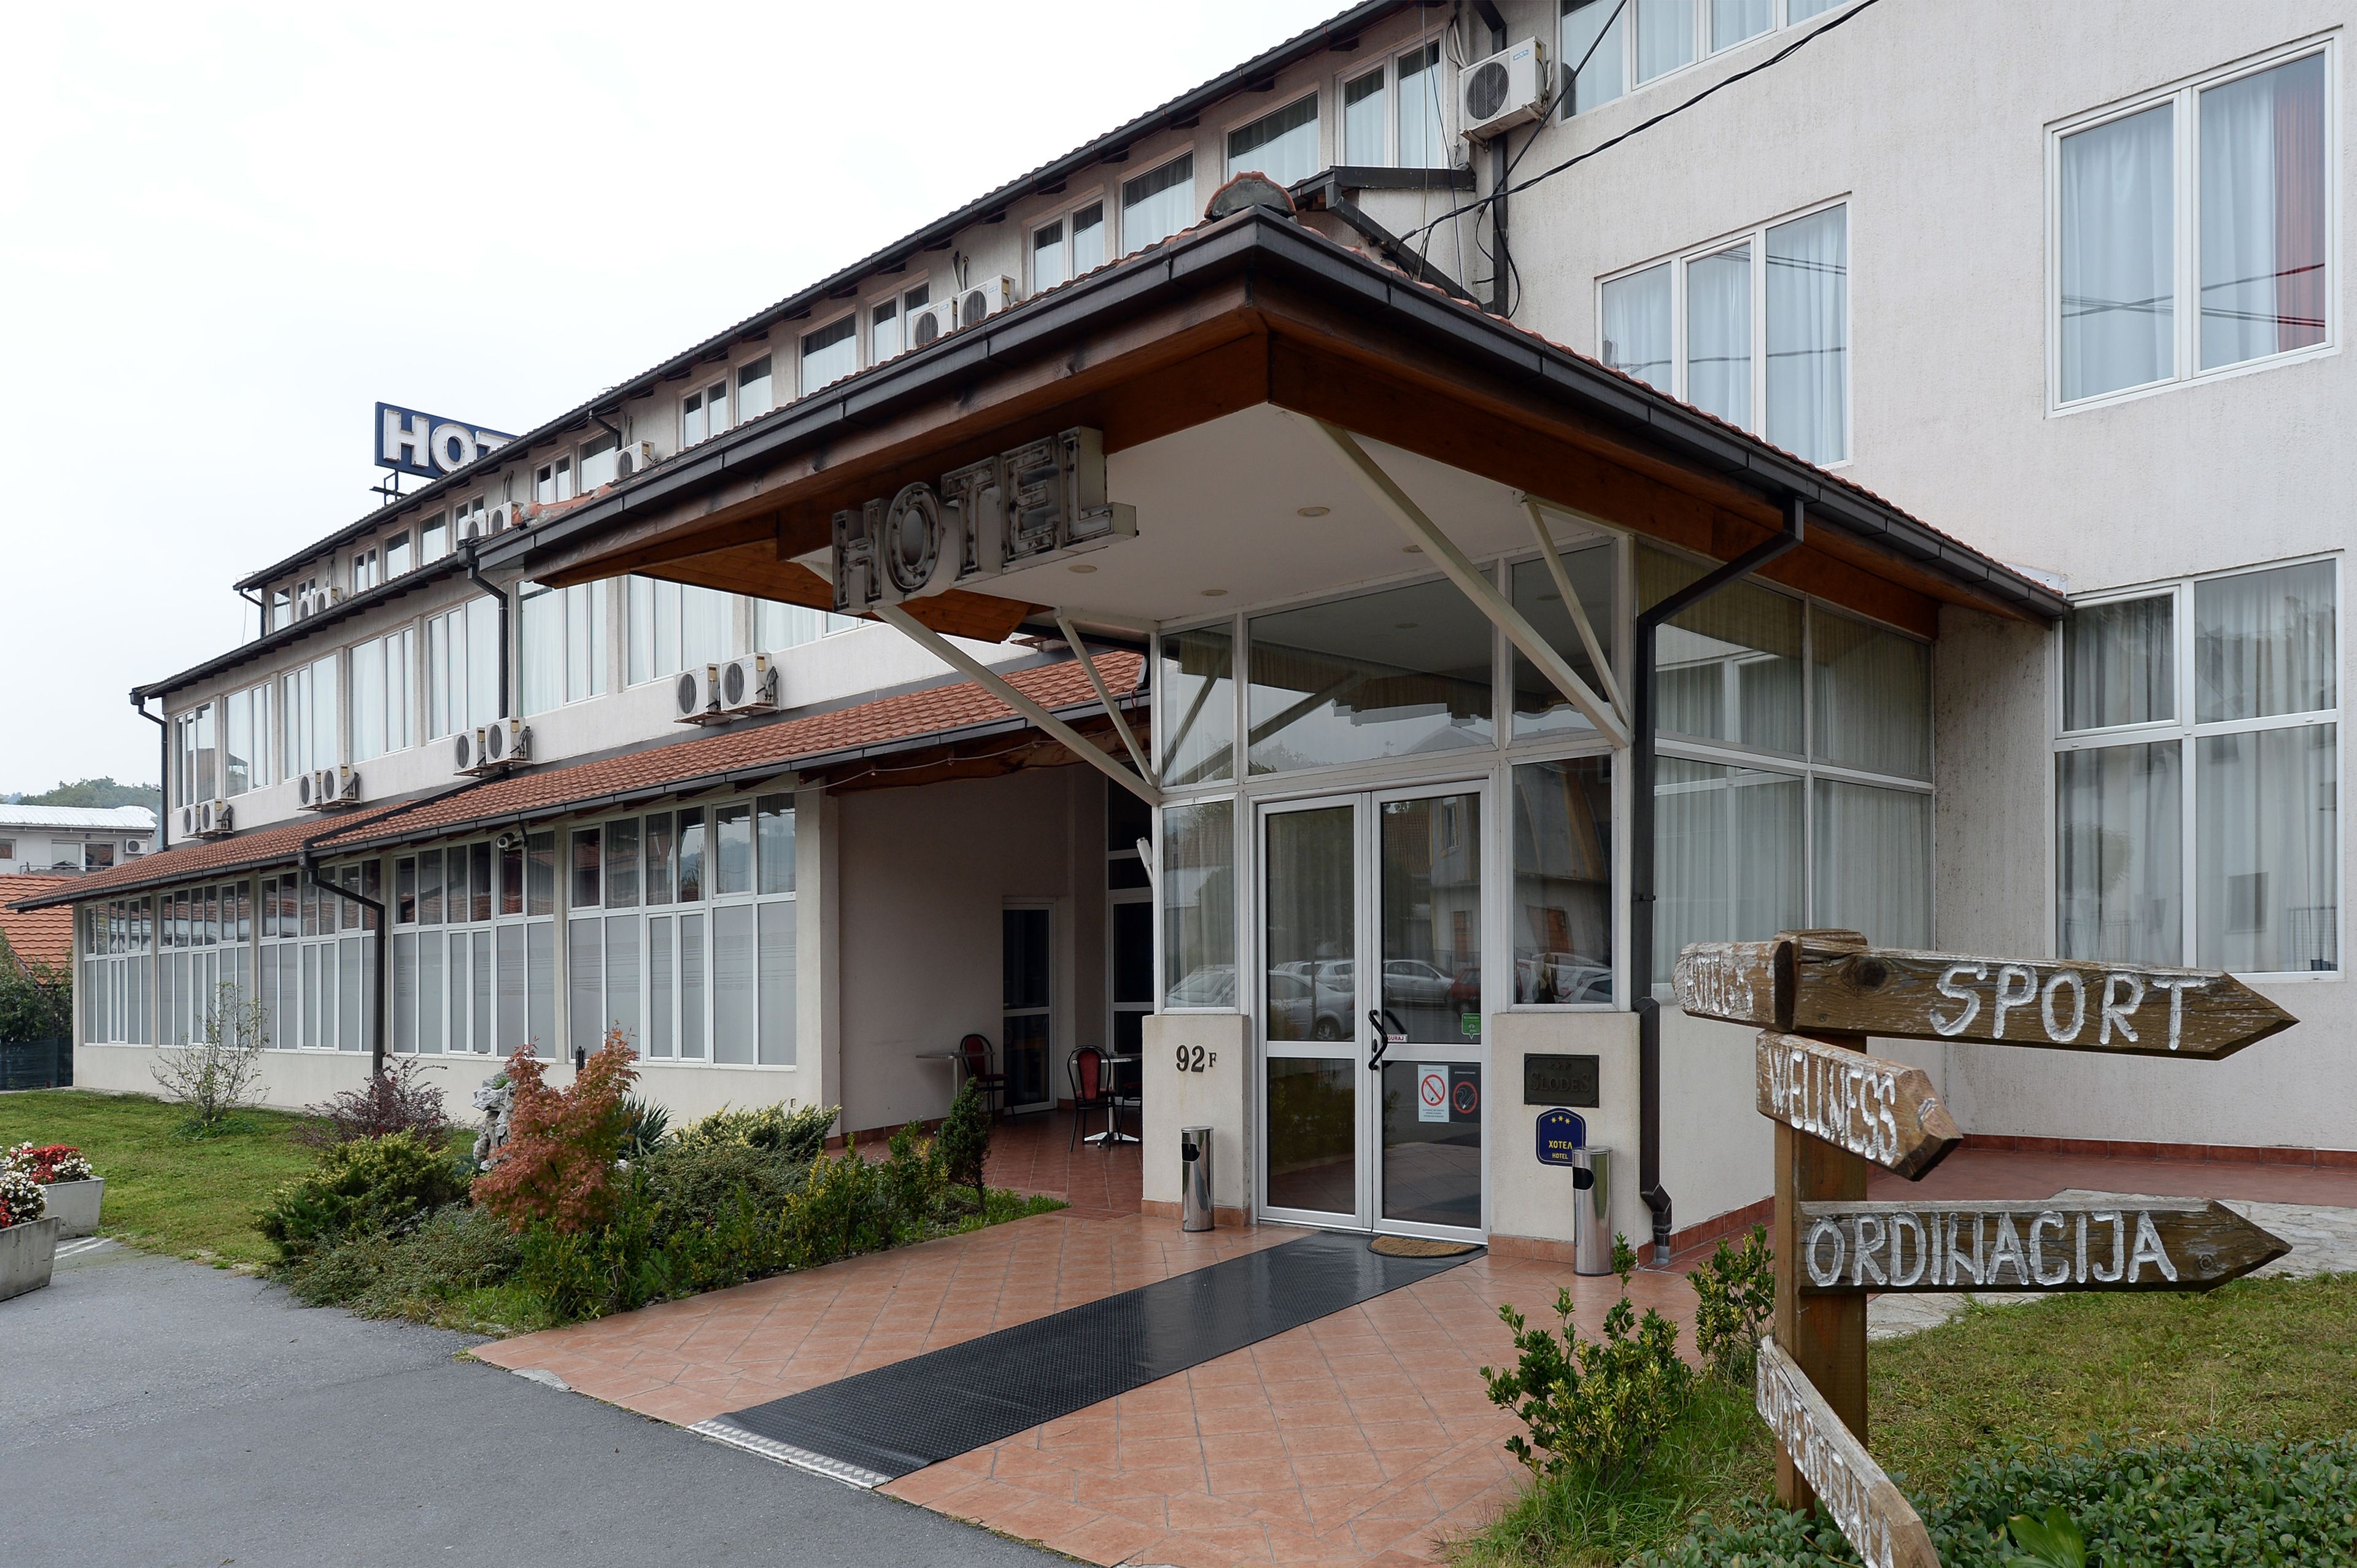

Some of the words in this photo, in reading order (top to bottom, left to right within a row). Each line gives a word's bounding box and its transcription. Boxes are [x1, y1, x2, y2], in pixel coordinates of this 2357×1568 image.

[832, 426, 1137, 613] HOTEL
[1929, 962, 2210, 1051] SPORT
[1549, 1140, 1573, 1150] ХОТЕЛ
[1767, 1045, 1898, 1166] WELLNESS
[1805, 1210, 2178, 1288] ORDINACIJA
